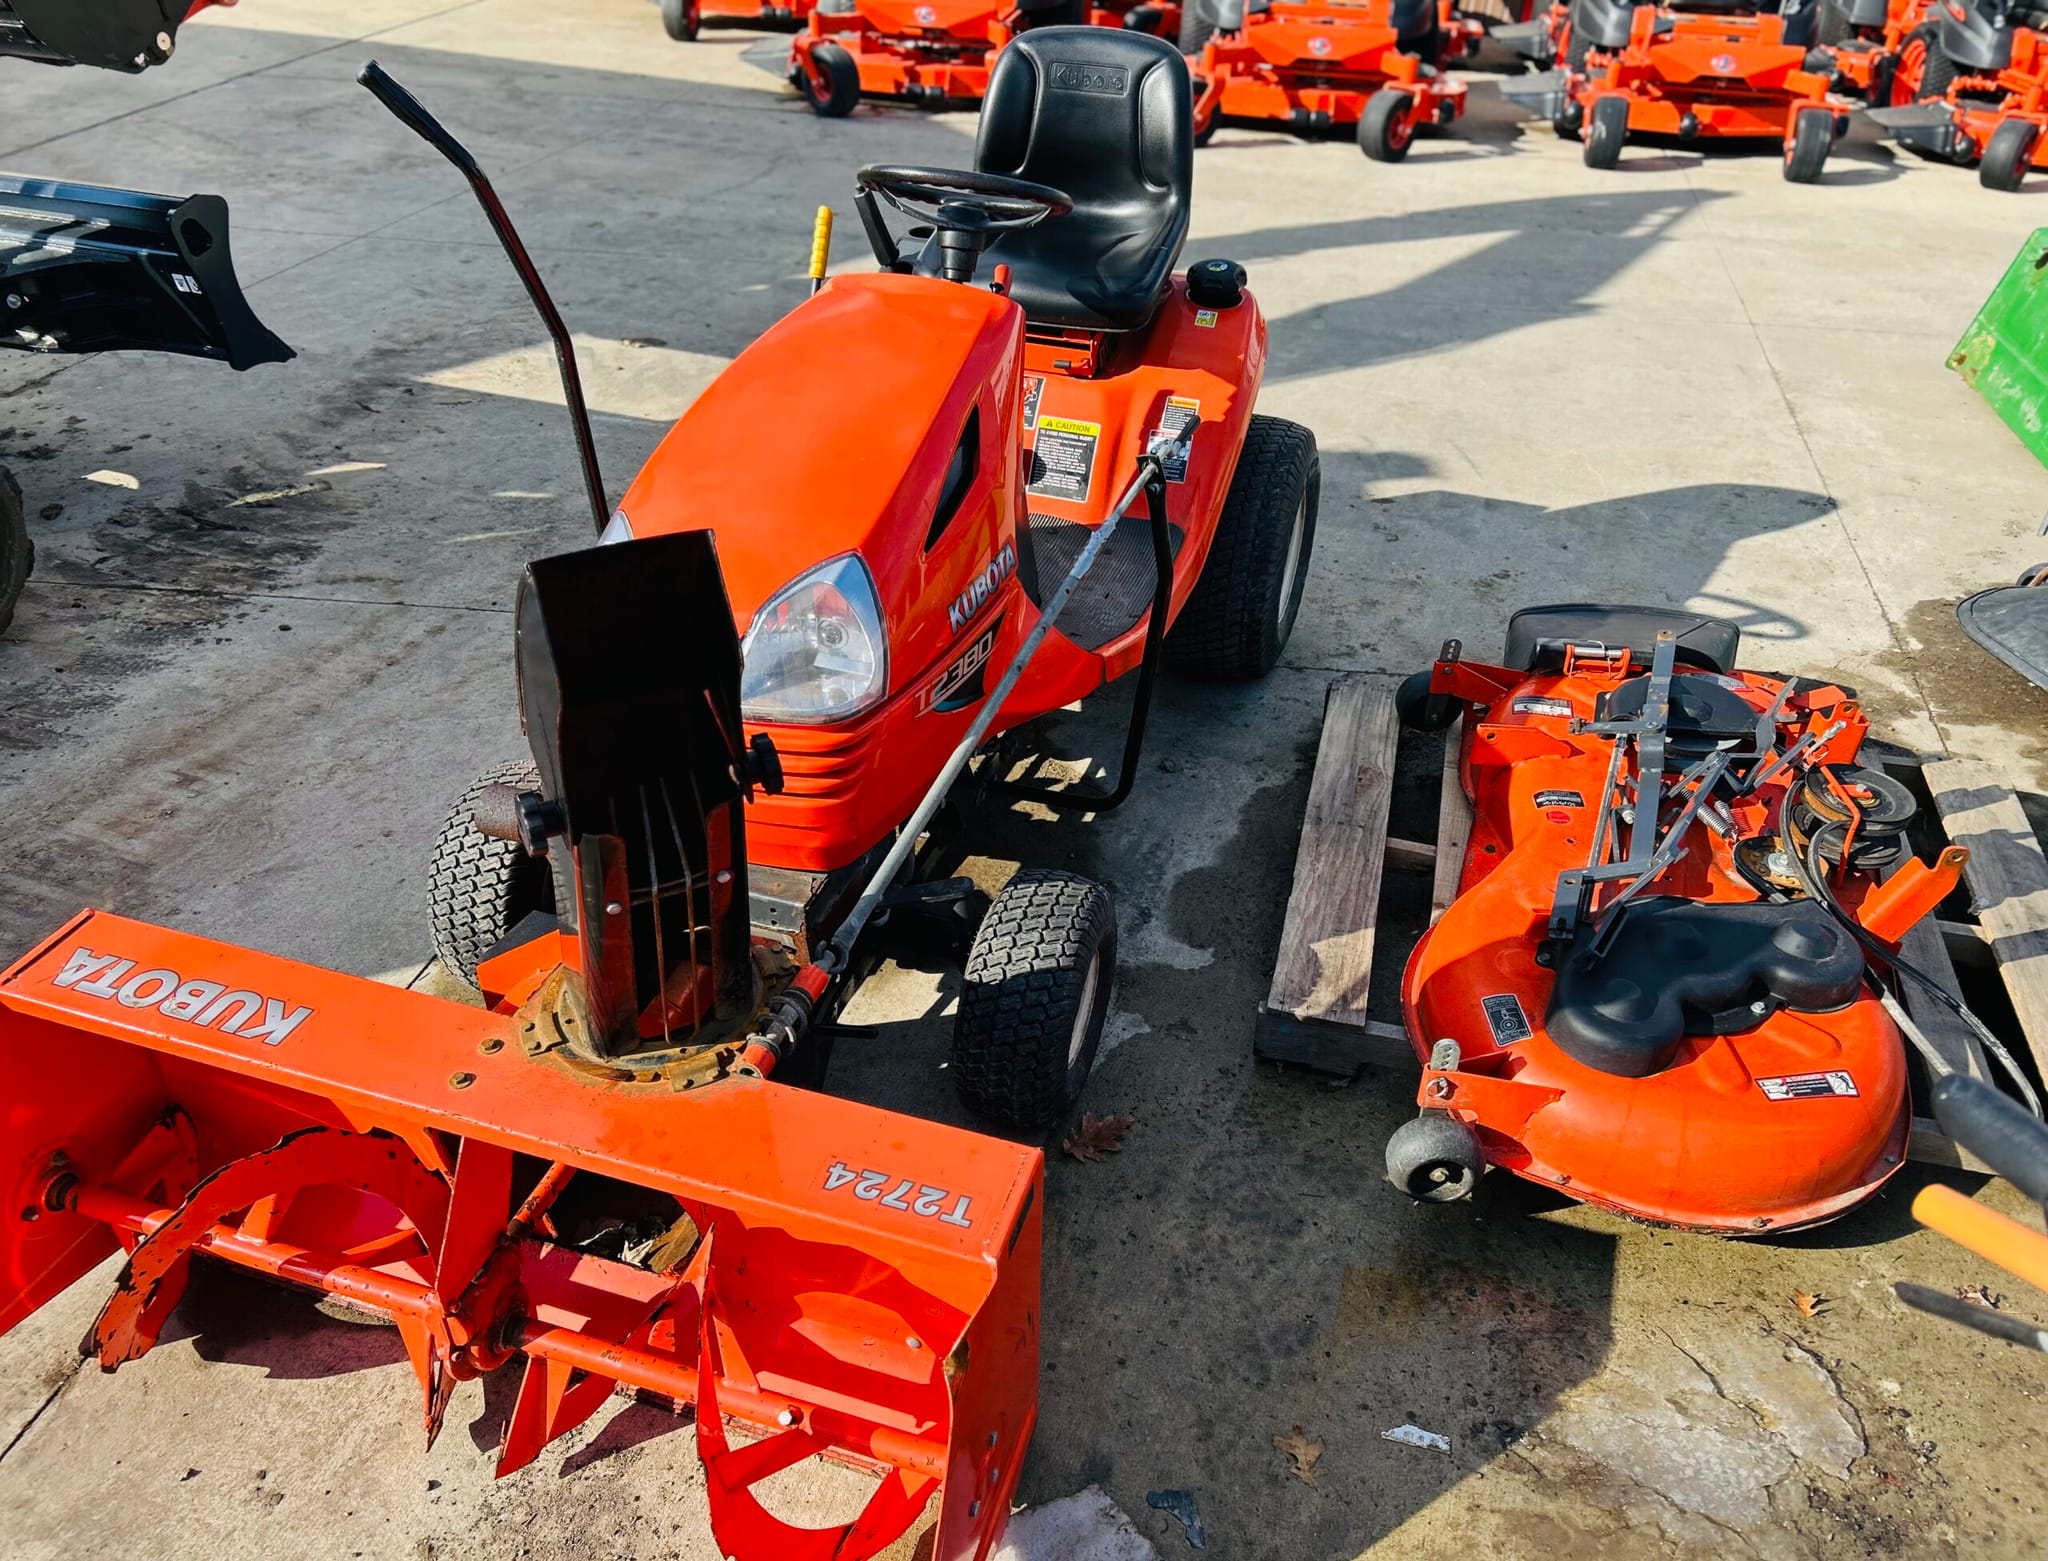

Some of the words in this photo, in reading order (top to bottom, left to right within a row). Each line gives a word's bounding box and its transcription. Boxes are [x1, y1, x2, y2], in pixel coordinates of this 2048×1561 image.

[1050, 64, 1124, 91] Kubota
[1055, 421, 1091, 433] CAUTION
[948, 543, 1016, 635] KUBOTA
[914, 630, 994, 713] T2380
[52, 946, 315, 1047] KUBOTA
[823, 1162, 973, 1229] T2724
